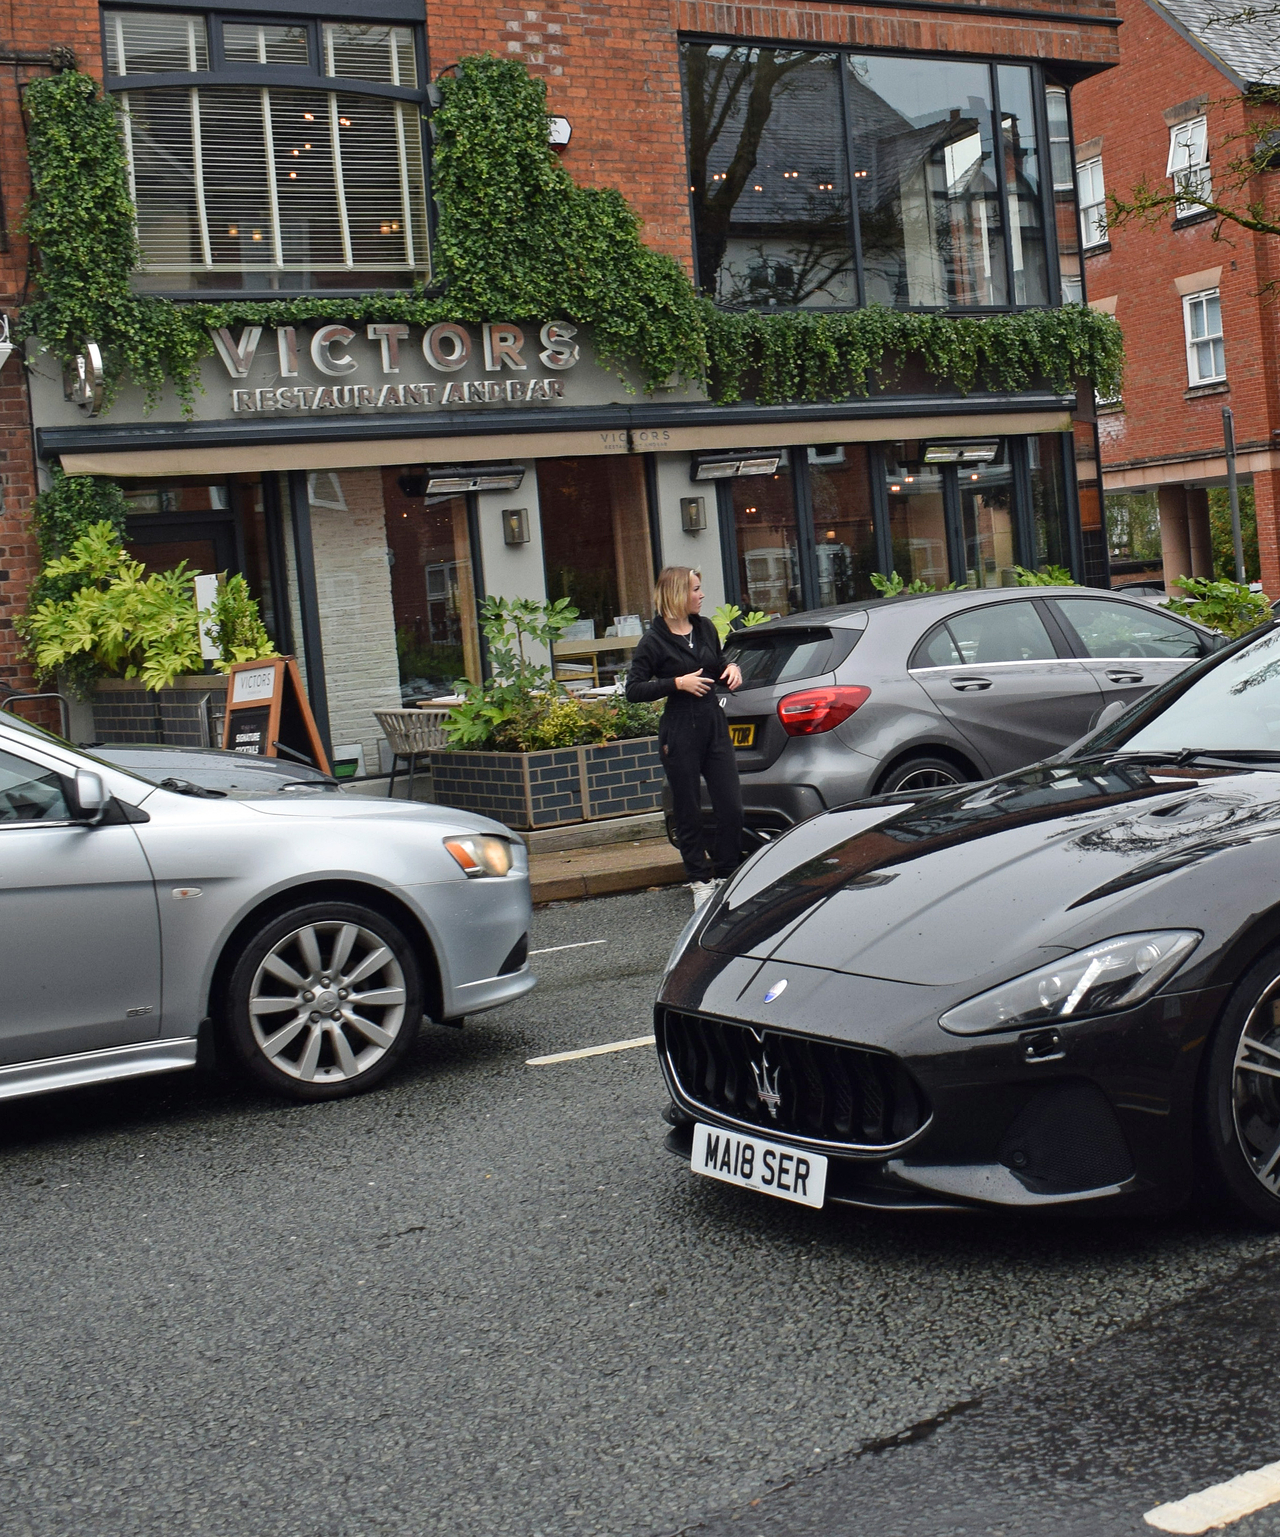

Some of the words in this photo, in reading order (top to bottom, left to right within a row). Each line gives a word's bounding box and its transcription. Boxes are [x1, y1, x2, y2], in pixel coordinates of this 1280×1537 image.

[208, 320, 580, 378] VICTORS
[232, 383, 437, 412] RESTAURANT
[441, 380, 501, 405] AND
[505, 378, 566, 401] BAR
[241, 673, 271, 689] VICTORS
[235, 732, 261, 743] SIGNATURE
[704, 1132, 755, 1180] MA18
[761, 1148, 810, 1196] SER
